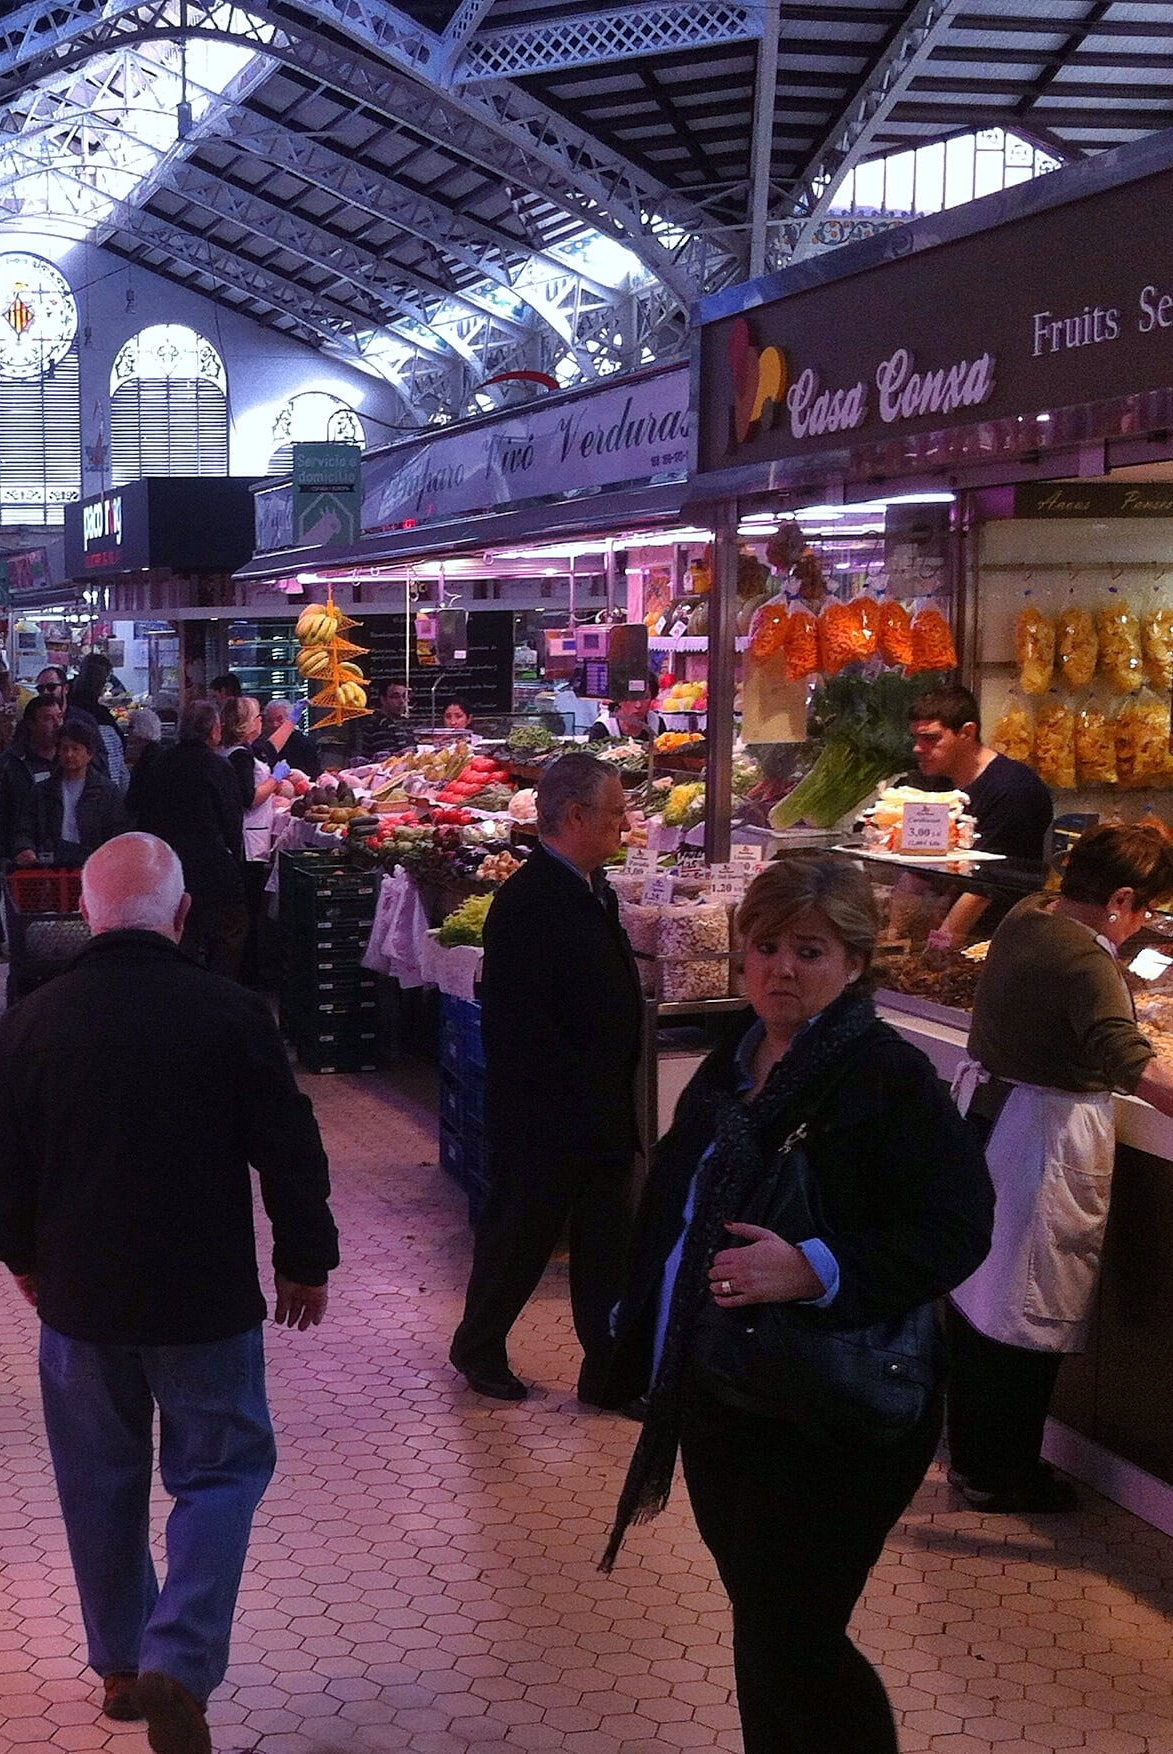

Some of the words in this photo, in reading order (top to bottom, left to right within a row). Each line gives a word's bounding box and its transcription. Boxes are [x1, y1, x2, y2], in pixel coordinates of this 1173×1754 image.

[1031, 306, 1121, 357] Fruits
[787, 367, 866, 439] Casa
[876, 348, 995, 423] Conxa
[298, 470, 355, 484] domicilio
